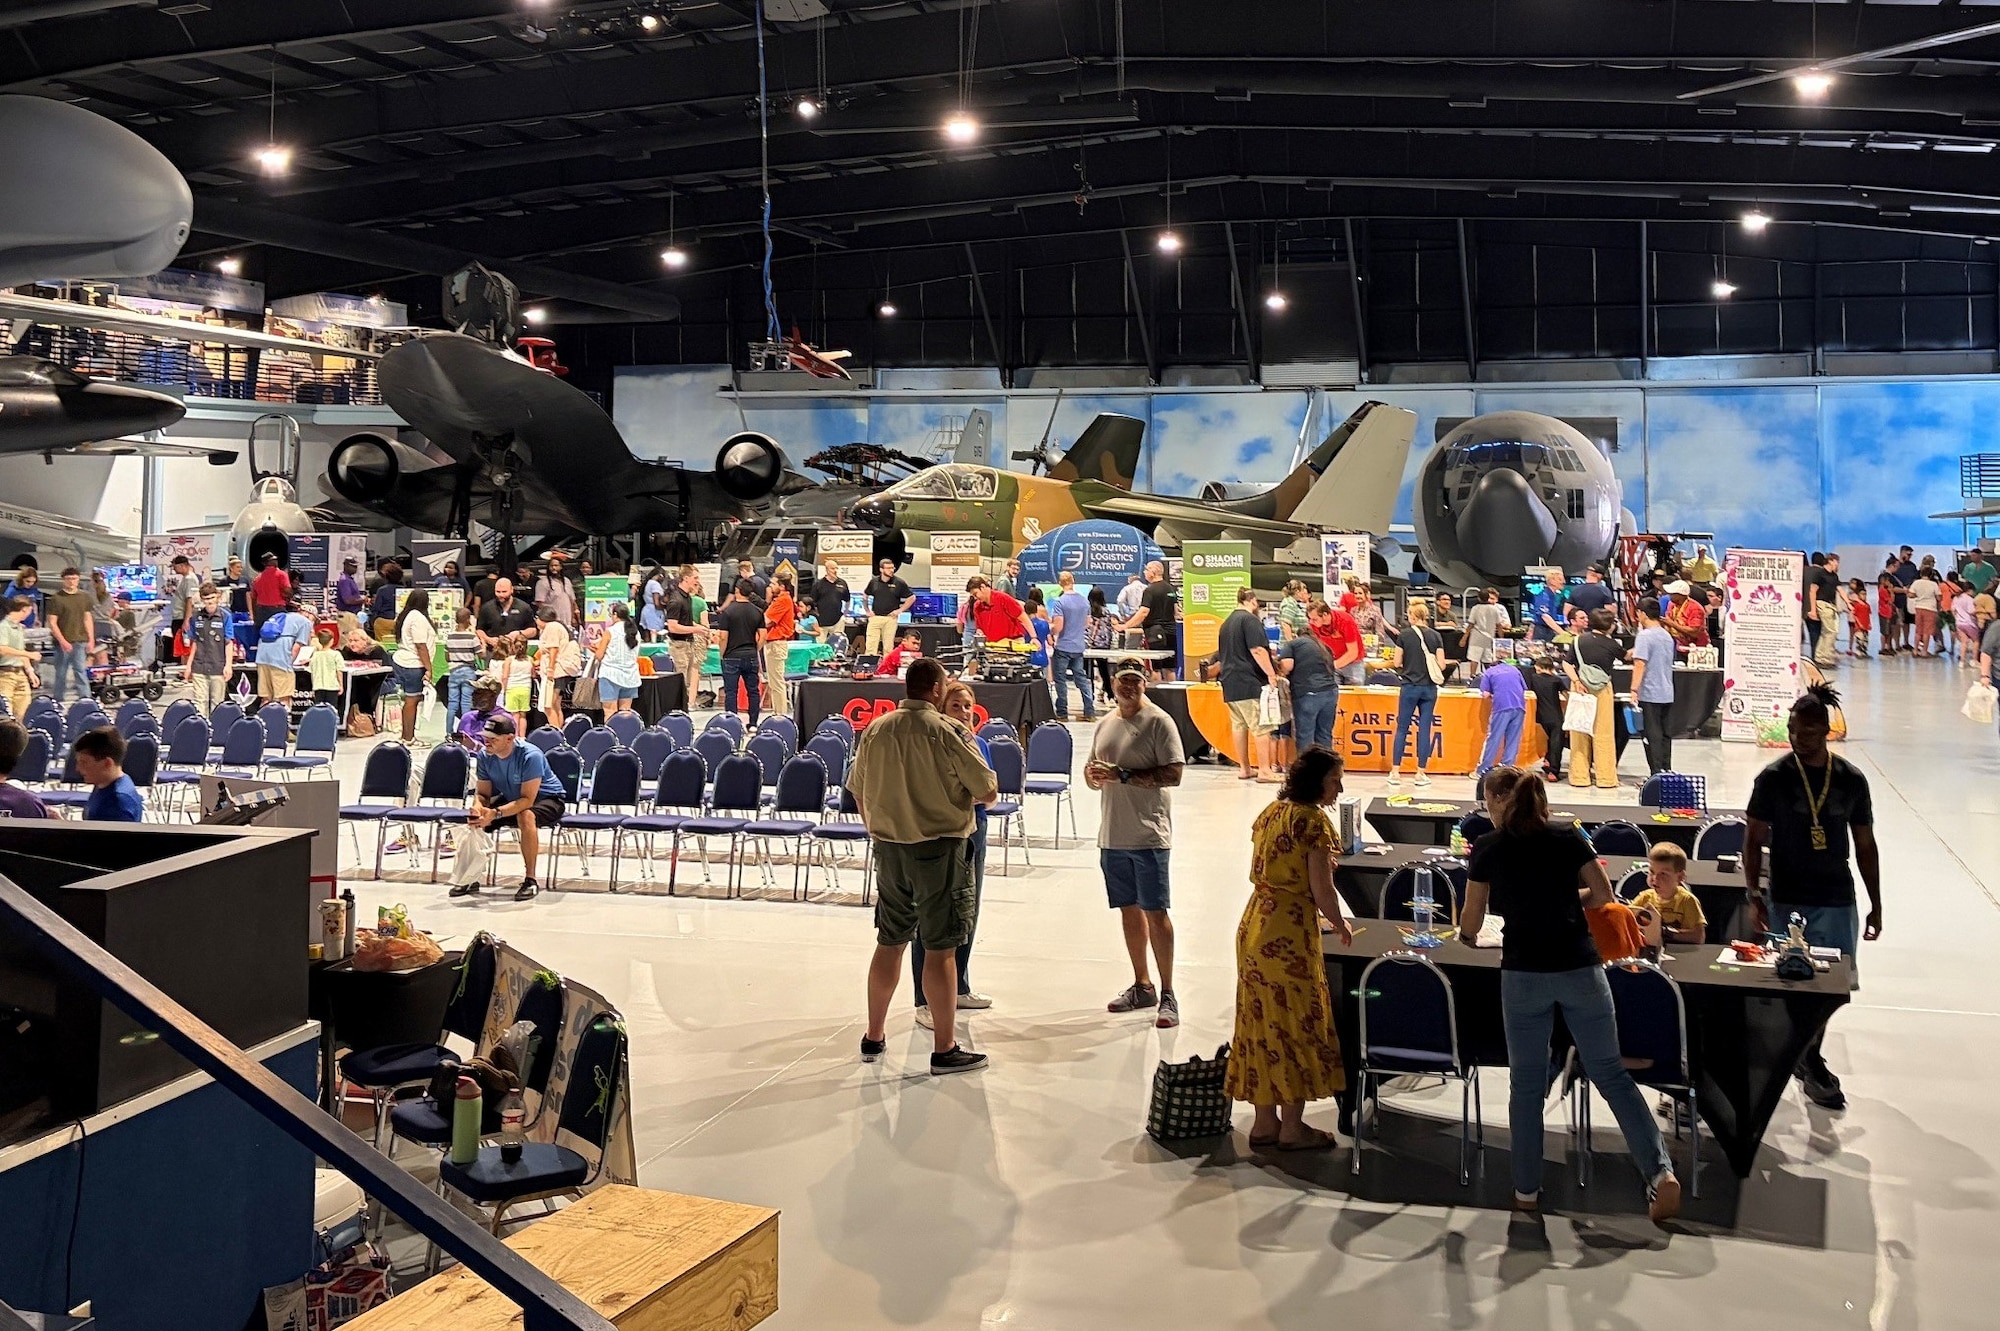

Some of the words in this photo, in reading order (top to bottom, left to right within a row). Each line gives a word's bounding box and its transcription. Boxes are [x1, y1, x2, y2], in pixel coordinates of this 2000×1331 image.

[1090, 543, 1138, 553] SOLUTIONS
[1091, 553, 1134, 562] LOGISTICS
[1777, 557, 1789, 569] GAP
[1091, 562, 1126, 571] PATRIOT
[1746, 568, 1762, 580] GIRLS
[1764, 569, 1770, 580] IN
[1351, 712, 1380, 725] AIR
[1386, 713, 1442, 727] FRE
[1351, 729, 1442, 758] STEM
